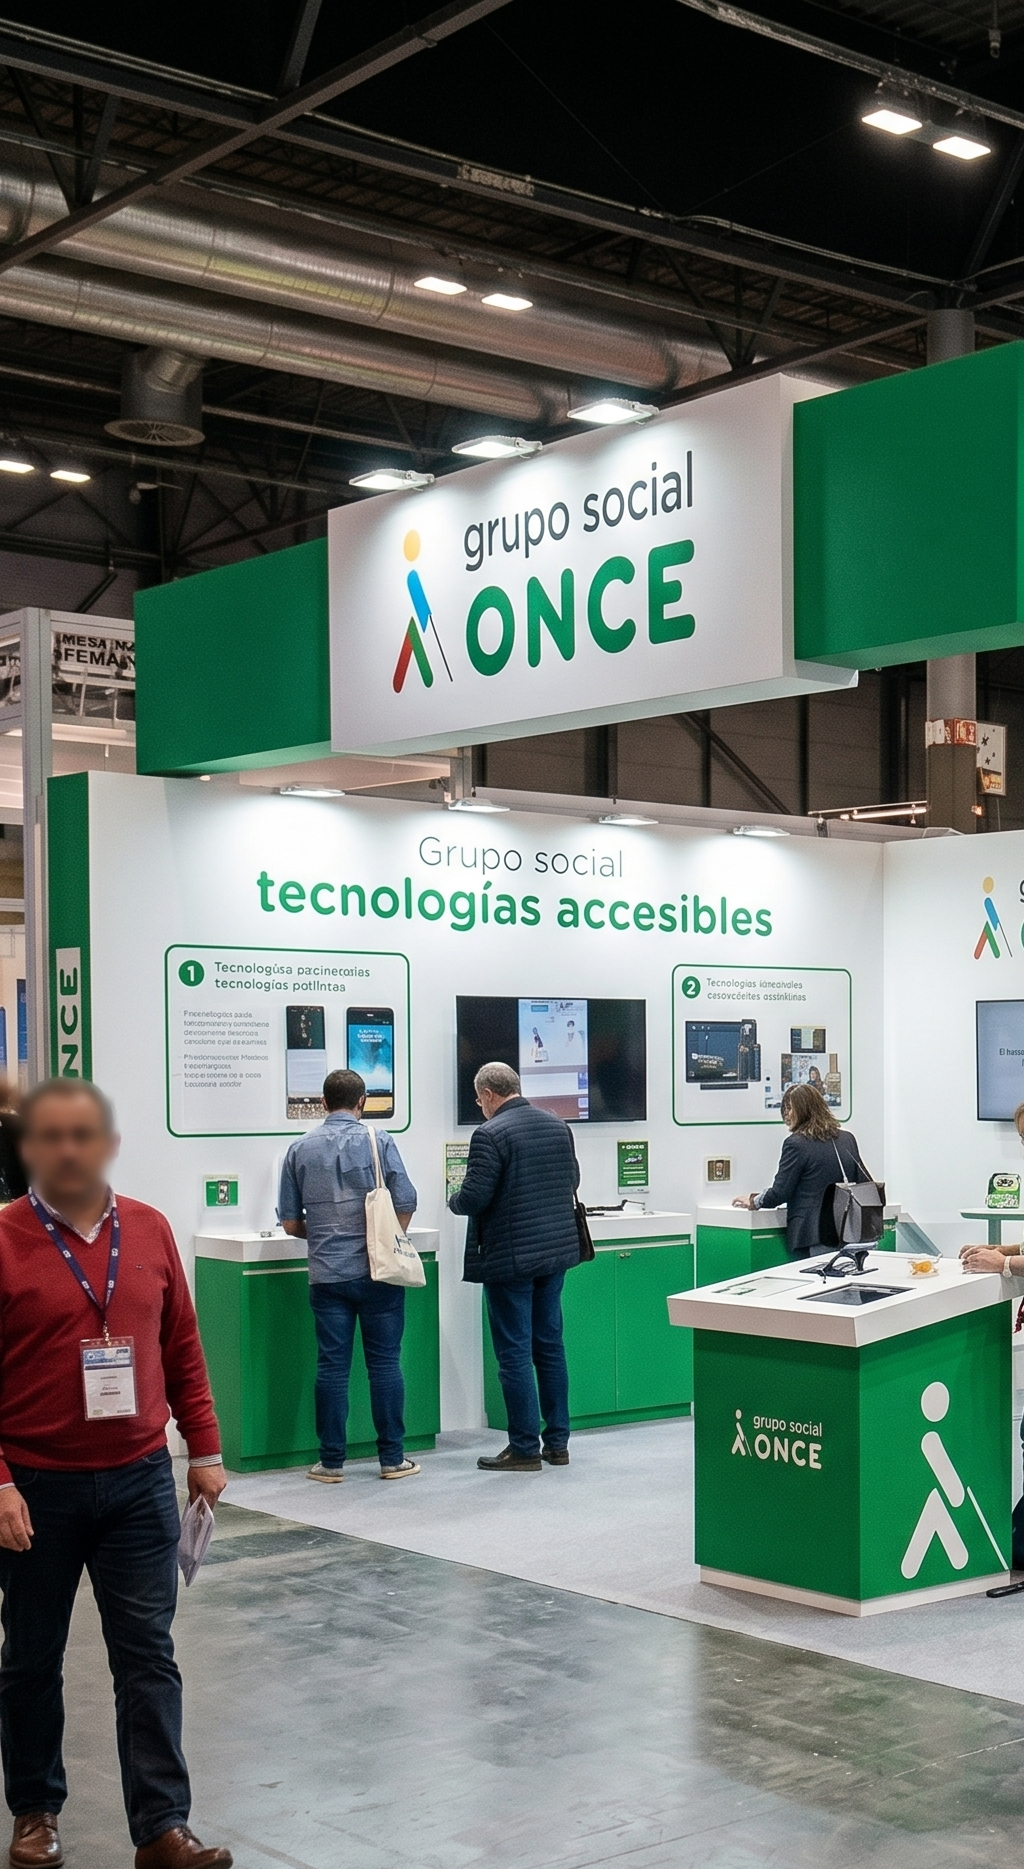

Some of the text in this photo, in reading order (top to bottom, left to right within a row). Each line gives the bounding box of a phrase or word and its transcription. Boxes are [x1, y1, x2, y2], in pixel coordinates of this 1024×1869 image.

[463, 450, 693, 572] grupo social
[466, 539, 696, 676] ONCE
[62, 633, 107, 649] MESA
[419, 836, 623, 878] Grupo social
[257, 871, 773, 937] tecnologías accesibles
[187, 965, 195, 982] 1
[686, 981, 696, 995] 2
[60, 967, 79, 1078] NCE
[753, 1415, 822, 1437] grupo social
[754, 1433, 822, 1470] ONCE
